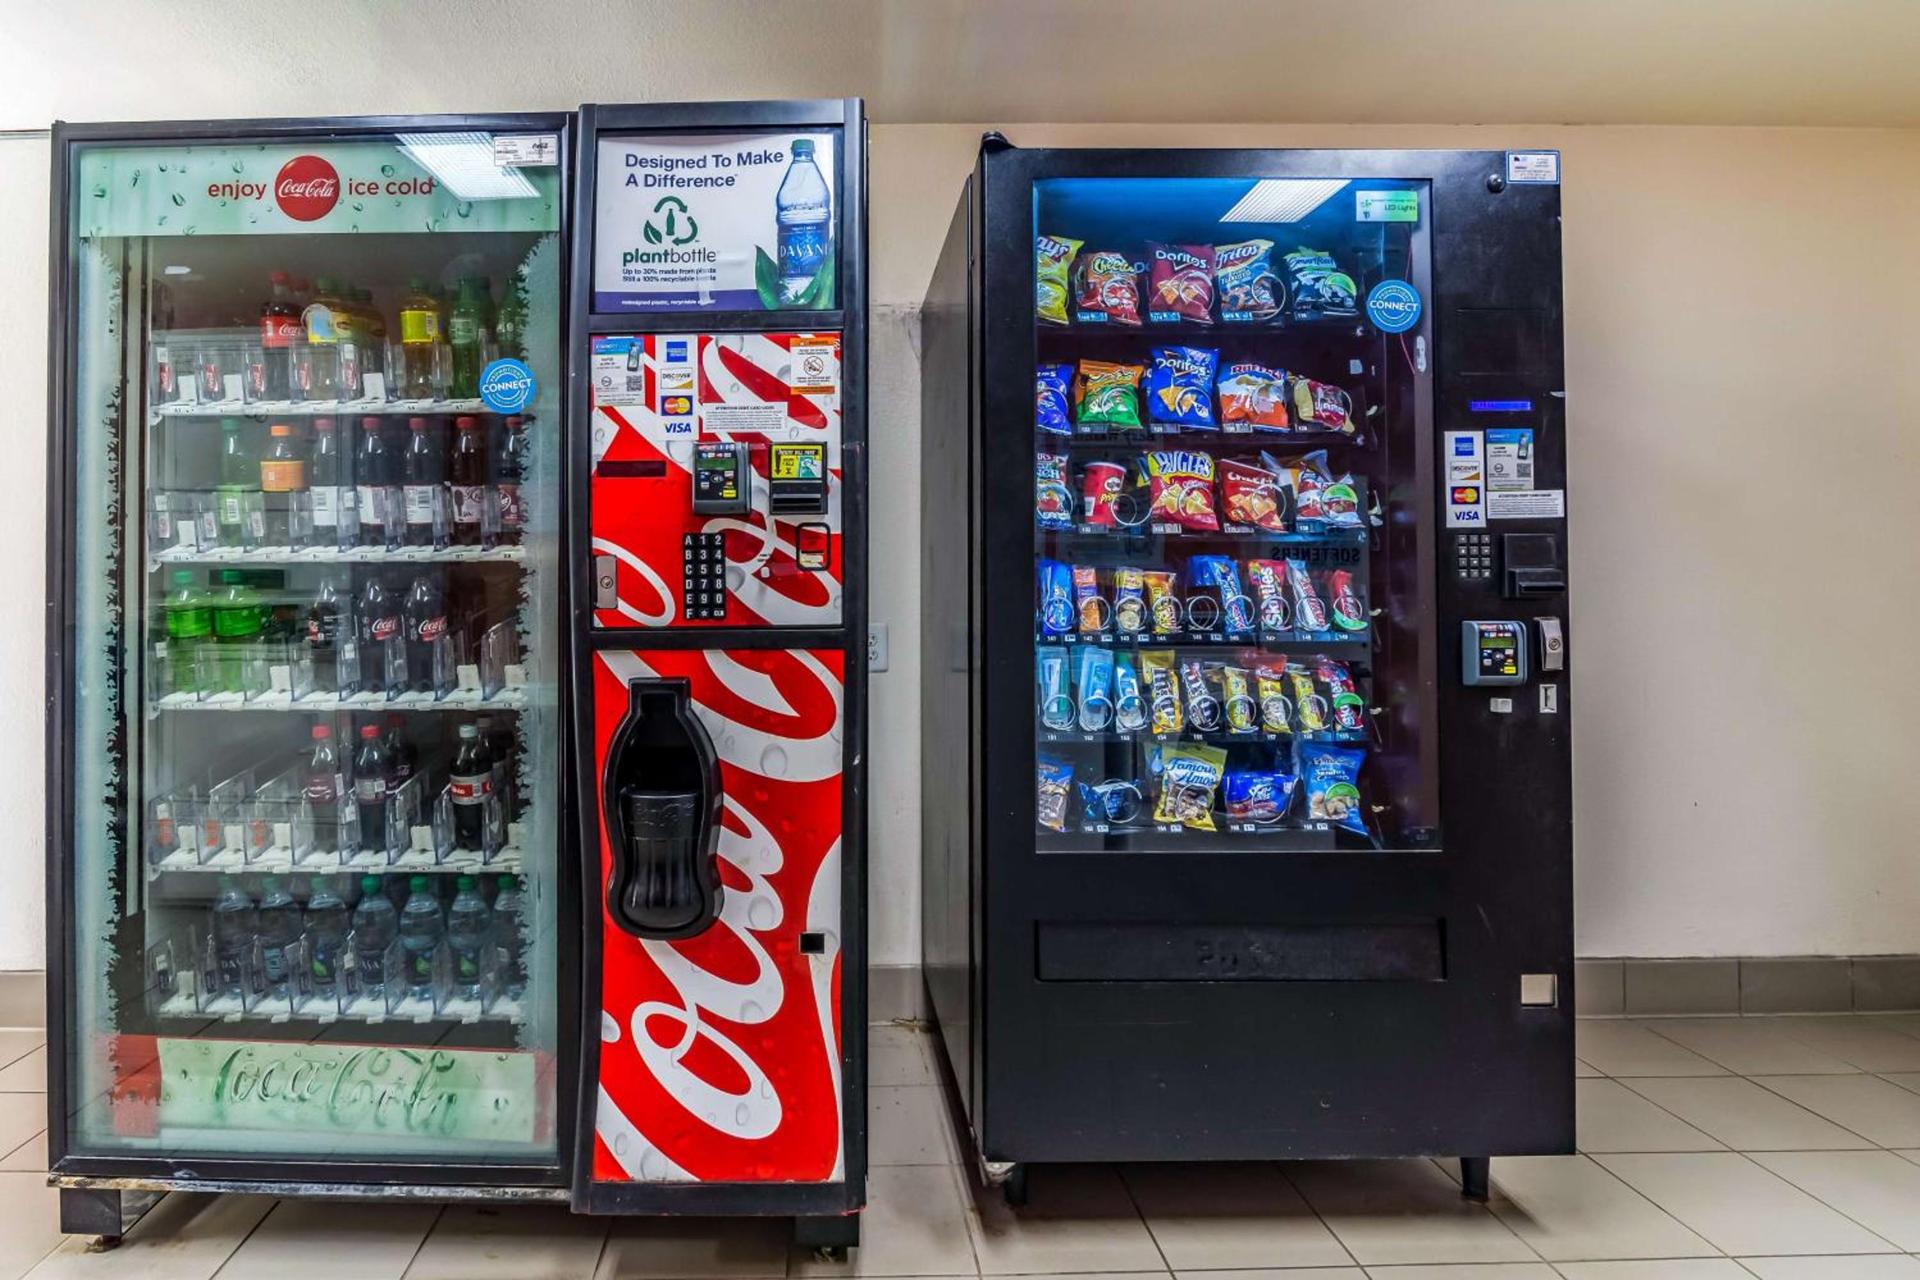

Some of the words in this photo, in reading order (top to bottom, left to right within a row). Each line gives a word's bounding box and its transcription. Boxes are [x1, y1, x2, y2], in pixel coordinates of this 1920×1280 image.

[625, 153, 707, 171] Designed
[712, 154, 732, 168] To
[736, 150, 784, 166] Make
[625, 174, 639, 188] A
[643, 173, 736, 188] Difference
[208, 180, 267, 200] enjoy
[348, 178, 379, 196] ice
[385, 177, 434, 196] cold
[780, 243, 828, 258] DASANI
[622, 248, 717, 268] plantbottle
[1155, 250, 1208, 269] Doritos
[1369, 300, 1419, 311] CONNECT
[1156, 357, 1207, 376] Doritos
[482, 378, 532, 394] CONNECT
[664, 423, 692, 434] VISA
[1454, 511, 1480, 521] VISA
[685, 535, 692, 546] A
[700, 535, 706, 545] 1
[714, 535, 722, 545] 2
[685, 550, 692, 560] B
[700, 550, 707, 560] 3
[714, 549, 722, 559] 4
[685, 564, 693, 575] C
[700, 564, 707, 575] 5
[715, 564, 722, 575] 6
[685, 580, 692, 590] D
[701, 580, 707, 589] 7
[715, 580, 722, 589] 8
[686, 594, 693, 604] E
[701, 594, 708, 604] 9
[716, 594, 723, 604] 0
[686, 609, 693, 619] F
[1167, 758, 1217, 775] Famous
[1176, 771, 1217, 785] Amos
